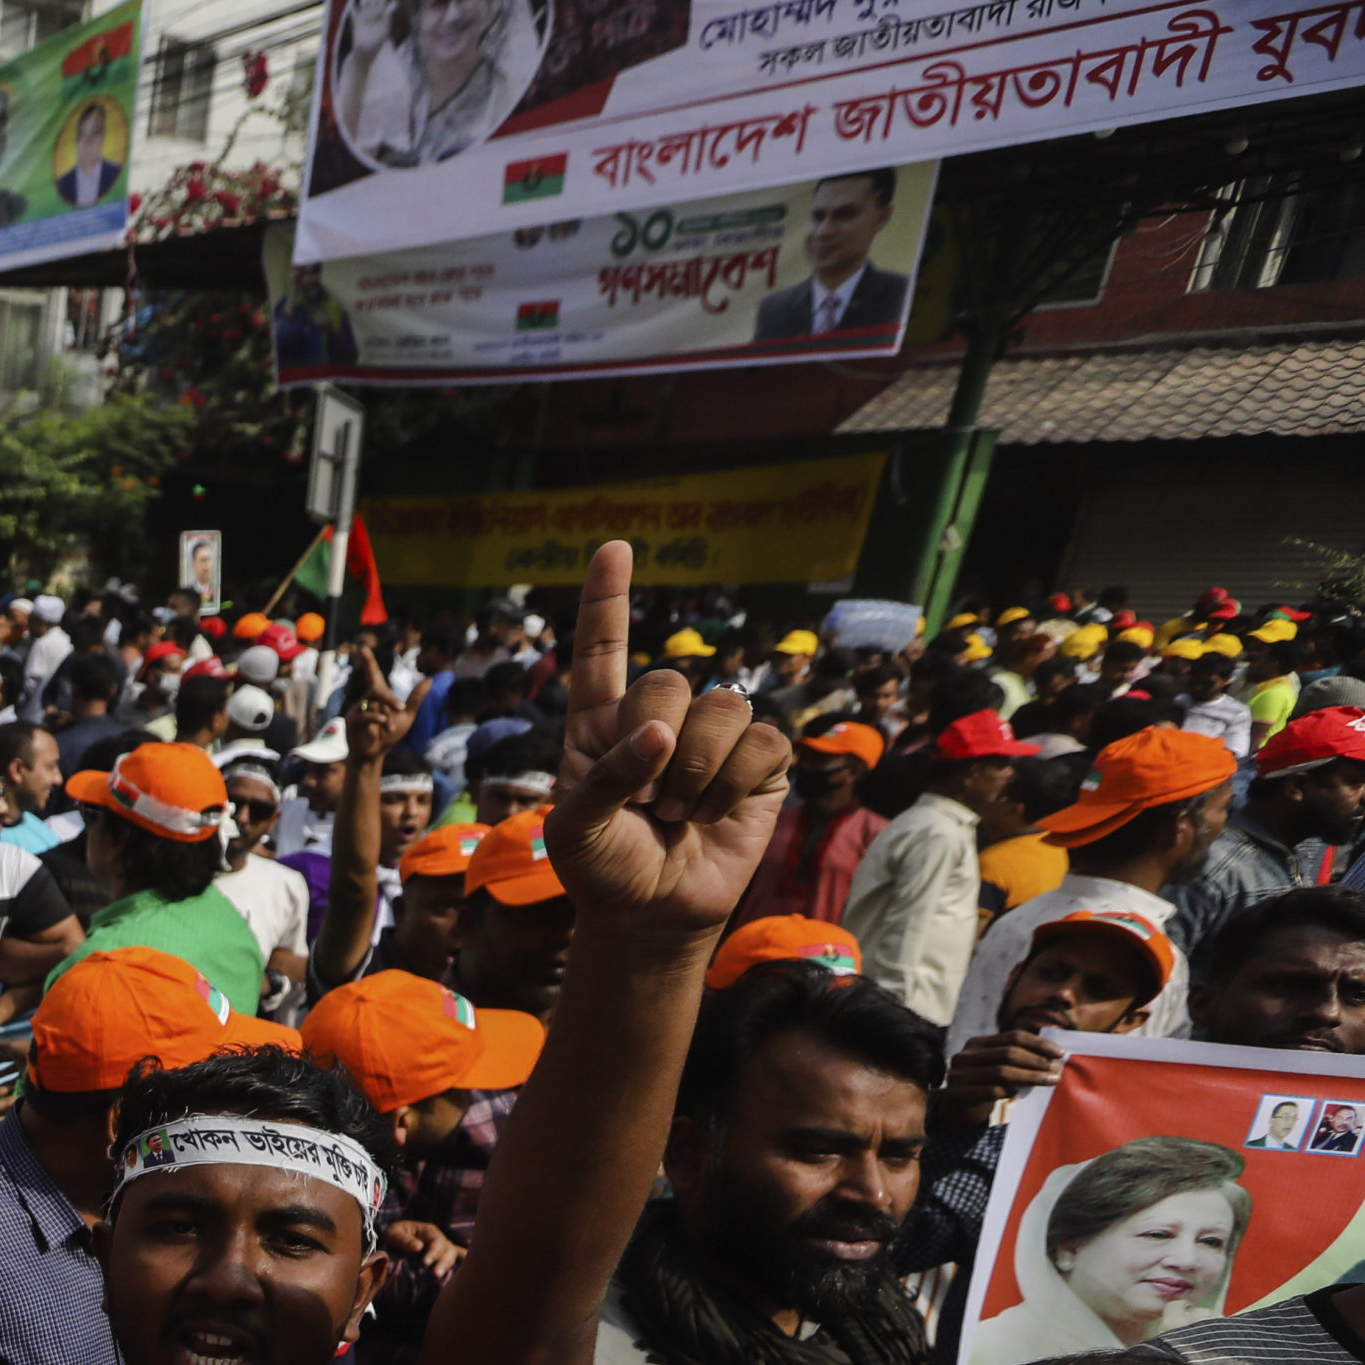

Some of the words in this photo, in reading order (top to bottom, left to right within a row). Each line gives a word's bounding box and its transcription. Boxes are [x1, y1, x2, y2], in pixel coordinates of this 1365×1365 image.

[757, 39, 827, 76] সকল
[832, 0, 1017, 59] জাতীয়তাবাদী
[592, 102, 819, 189] বাংলাদেশ
[832, 9, 1235, 143] জাতীয়তাবাদী
[1249, 0, 1365, 84] যুব
[611, 208, 673, 258] ১০
[596, 245, 783, 314] গণসমাবেশ
[170, 1127, 241, 1153] খোকন
[240, 1125, 321, 1166] ভাইয়ের
[318, 1144, 353, 1185] মুক্তি
[351, 1159, 370, 1193] চাই
